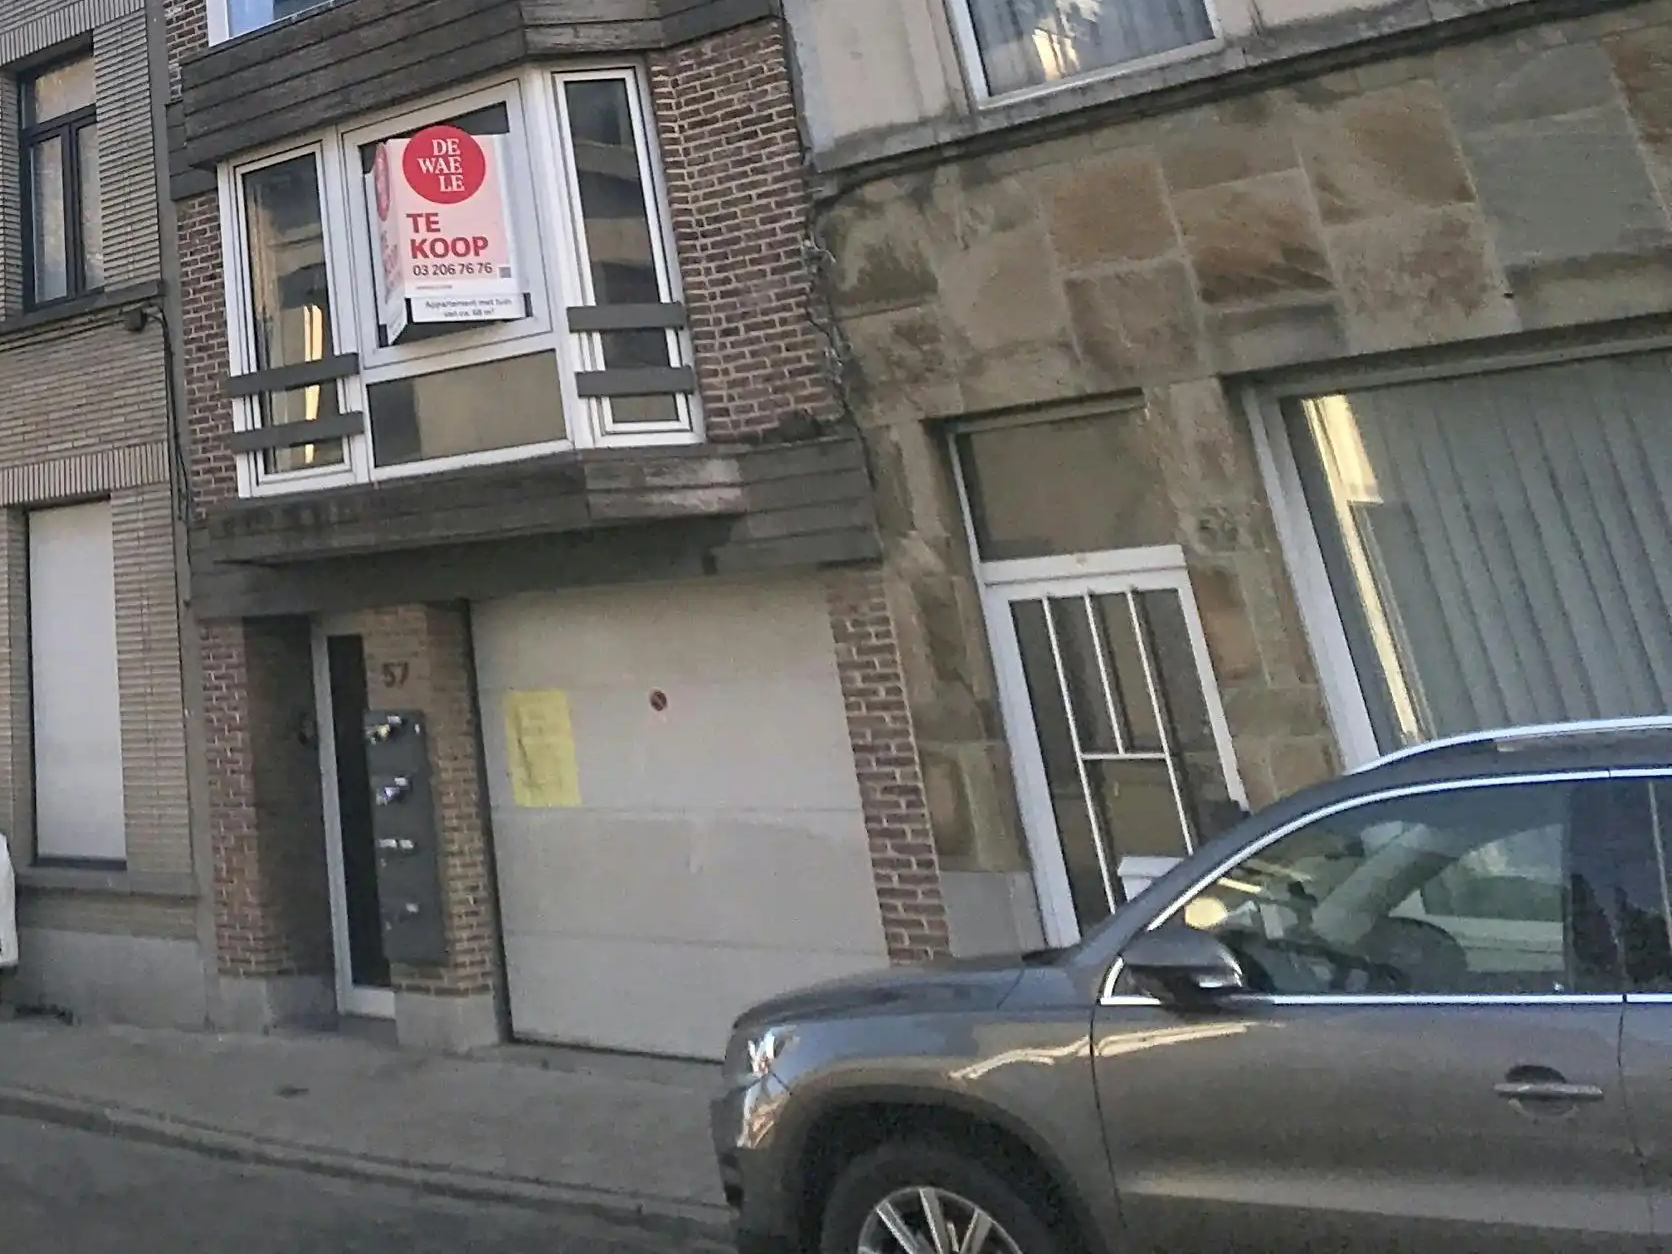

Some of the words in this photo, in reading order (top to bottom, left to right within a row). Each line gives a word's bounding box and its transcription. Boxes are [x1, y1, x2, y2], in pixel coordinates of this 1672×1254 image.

[432, 138, 461, 156] DE
[417, 156, 463, 174] WAE
[438, 175, 465, 191] LE
[406, 212, 441, 233] TE
[410, 236, 489, 259] KOOP
[412, 264, 429, 277] 03
[432, 263, 456, 276] 206
[457, 262, 475, 275] 76
[476, 261, 493, 274] 76
[381, 661, 410, 689] 57
